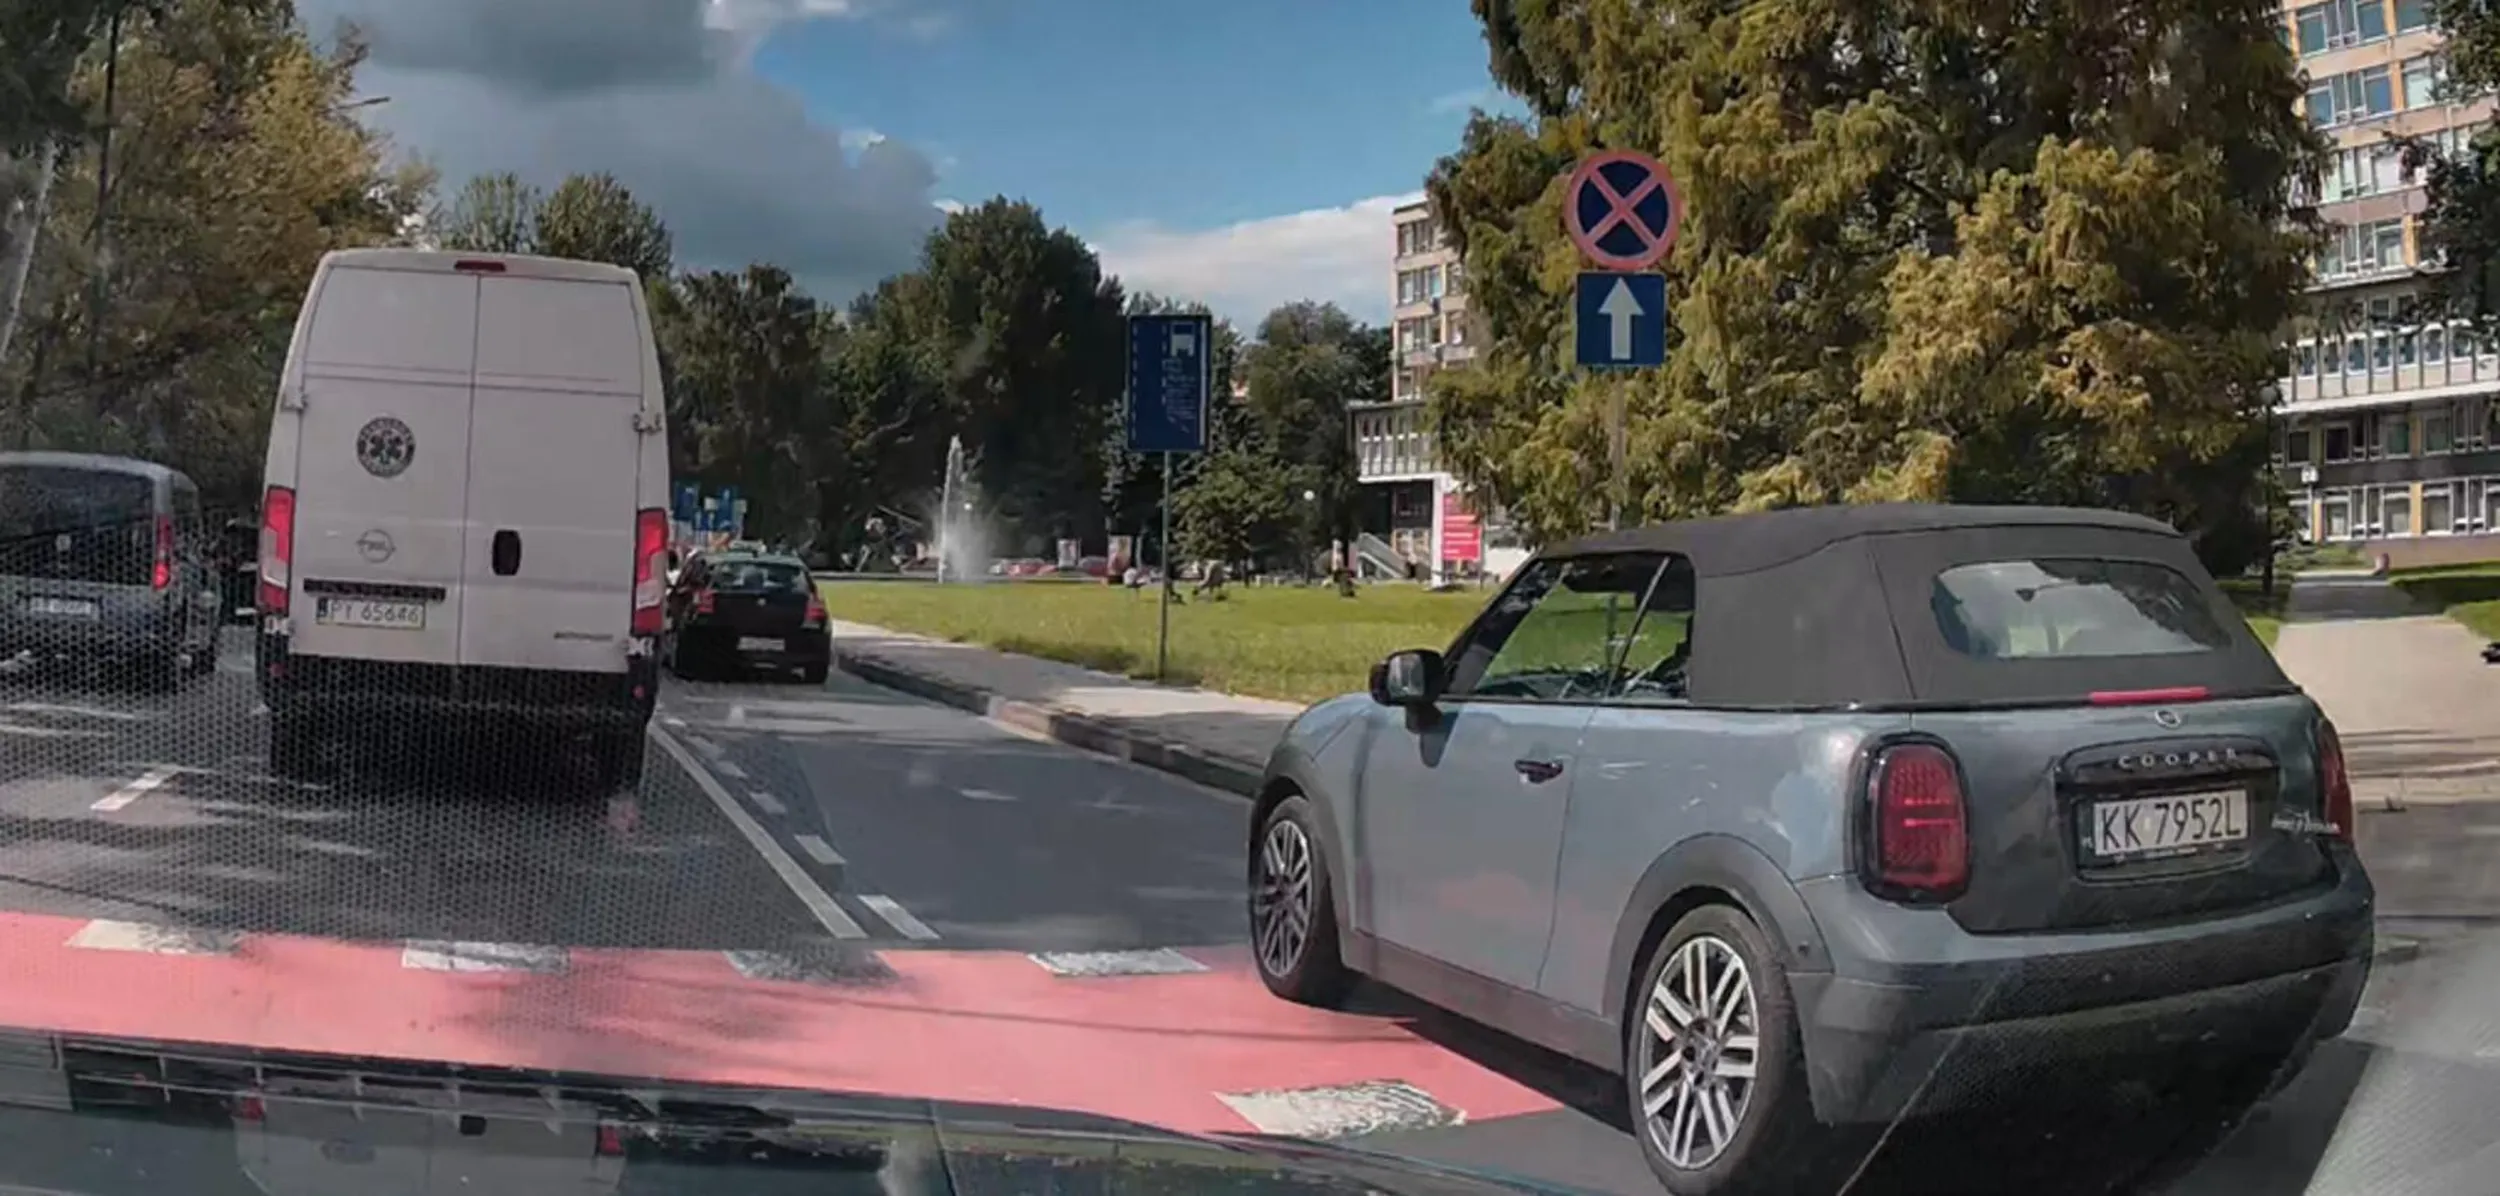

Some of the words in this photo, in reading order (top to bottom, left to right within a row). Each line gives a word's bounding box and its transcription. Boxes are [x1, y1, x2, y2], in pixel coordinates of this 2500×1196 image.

[2118, 748, 2238, 769] COOPER
[2101, 804, 2142, 850] KK
[2154, 795, 2241, 846] 7952L
